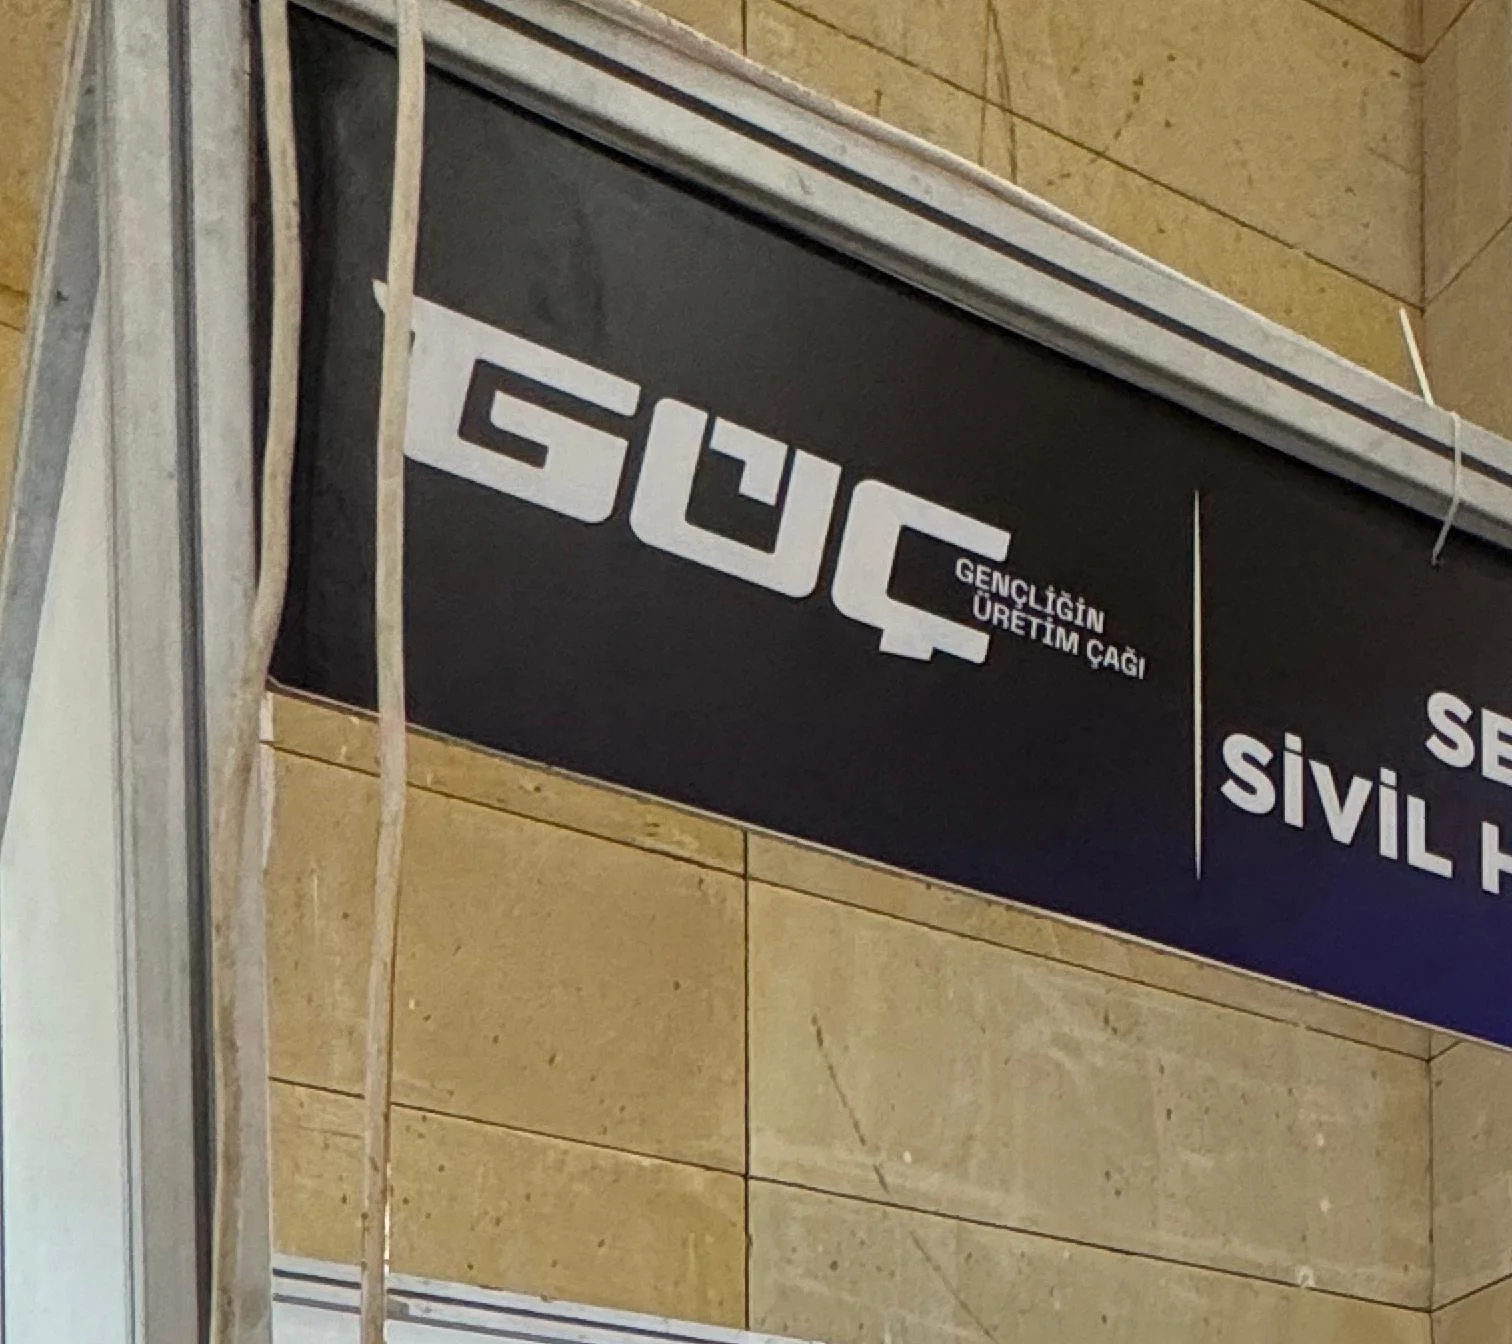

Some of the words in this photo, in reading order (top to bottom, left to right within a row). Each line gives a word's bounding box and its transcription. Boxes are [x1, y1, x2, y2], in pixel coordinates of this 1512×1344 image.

[954, 556, 1105, 635] GENÇLİĞİN
[972, 589, 1080, 656] ÜRETİM
[1086, 638, 1147, 680] ÇAĞI
[1220, 732, 1453, 878] SİVİL
